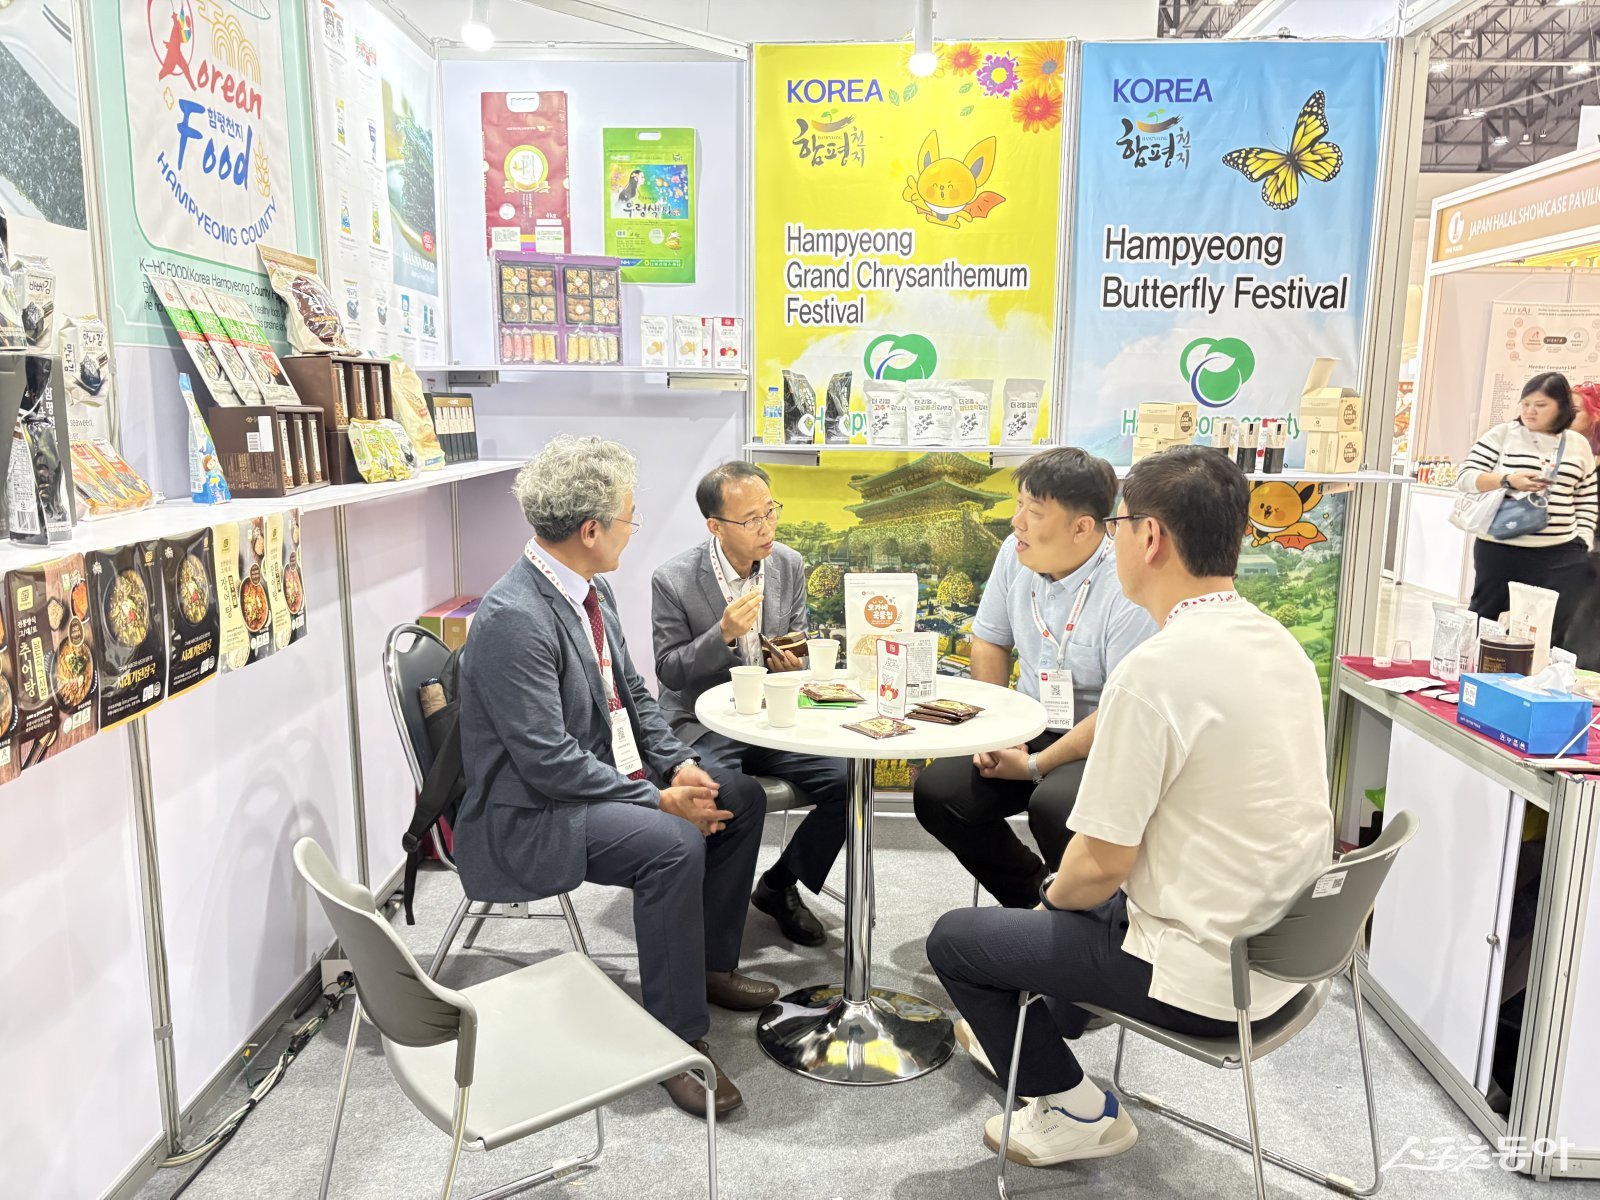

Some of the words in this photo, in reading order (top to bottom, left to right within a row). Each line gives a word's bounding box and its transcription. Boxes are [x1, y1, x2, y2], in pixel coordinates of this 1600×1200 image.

[787, 79, 883, 103] KOREA
[1113, 78, 1213, 103] KOREA
[206, 107, 244, 142] 함평천지
[792, 118, 850, 168] 함평
[1116, 118, 1175, 169] 함평
[176, 98, 253, 192] Food
[157, 151, 239, 247] HAMPYEONG
[240, 199, 278, 246] COUNTY
[1468, 220, 1492, 241] JAPAN
[1492, 209, 1517, 231] HALAL
[1518, 195, 1568, 224] SHOWCASE
[787, 225, 913, 257] Hampyeong
[1105, 228, 1284, 266] Hampyeong
[166, 263, 210, 284] FOOD(Korea
[211, 273, 250, 295] Hampyeong
[250, 283, 272, 301] County
[786, 261, 850, 288] Grand
[857, 261, 1028, 292] Chrysanthemum
[1102, 276, 1225, 313] Butterfly
[1234, 276, 1348, 309] Festival
[786, 297, 864, 324] Festival
[19, 642, 37, 698] 추어탕
